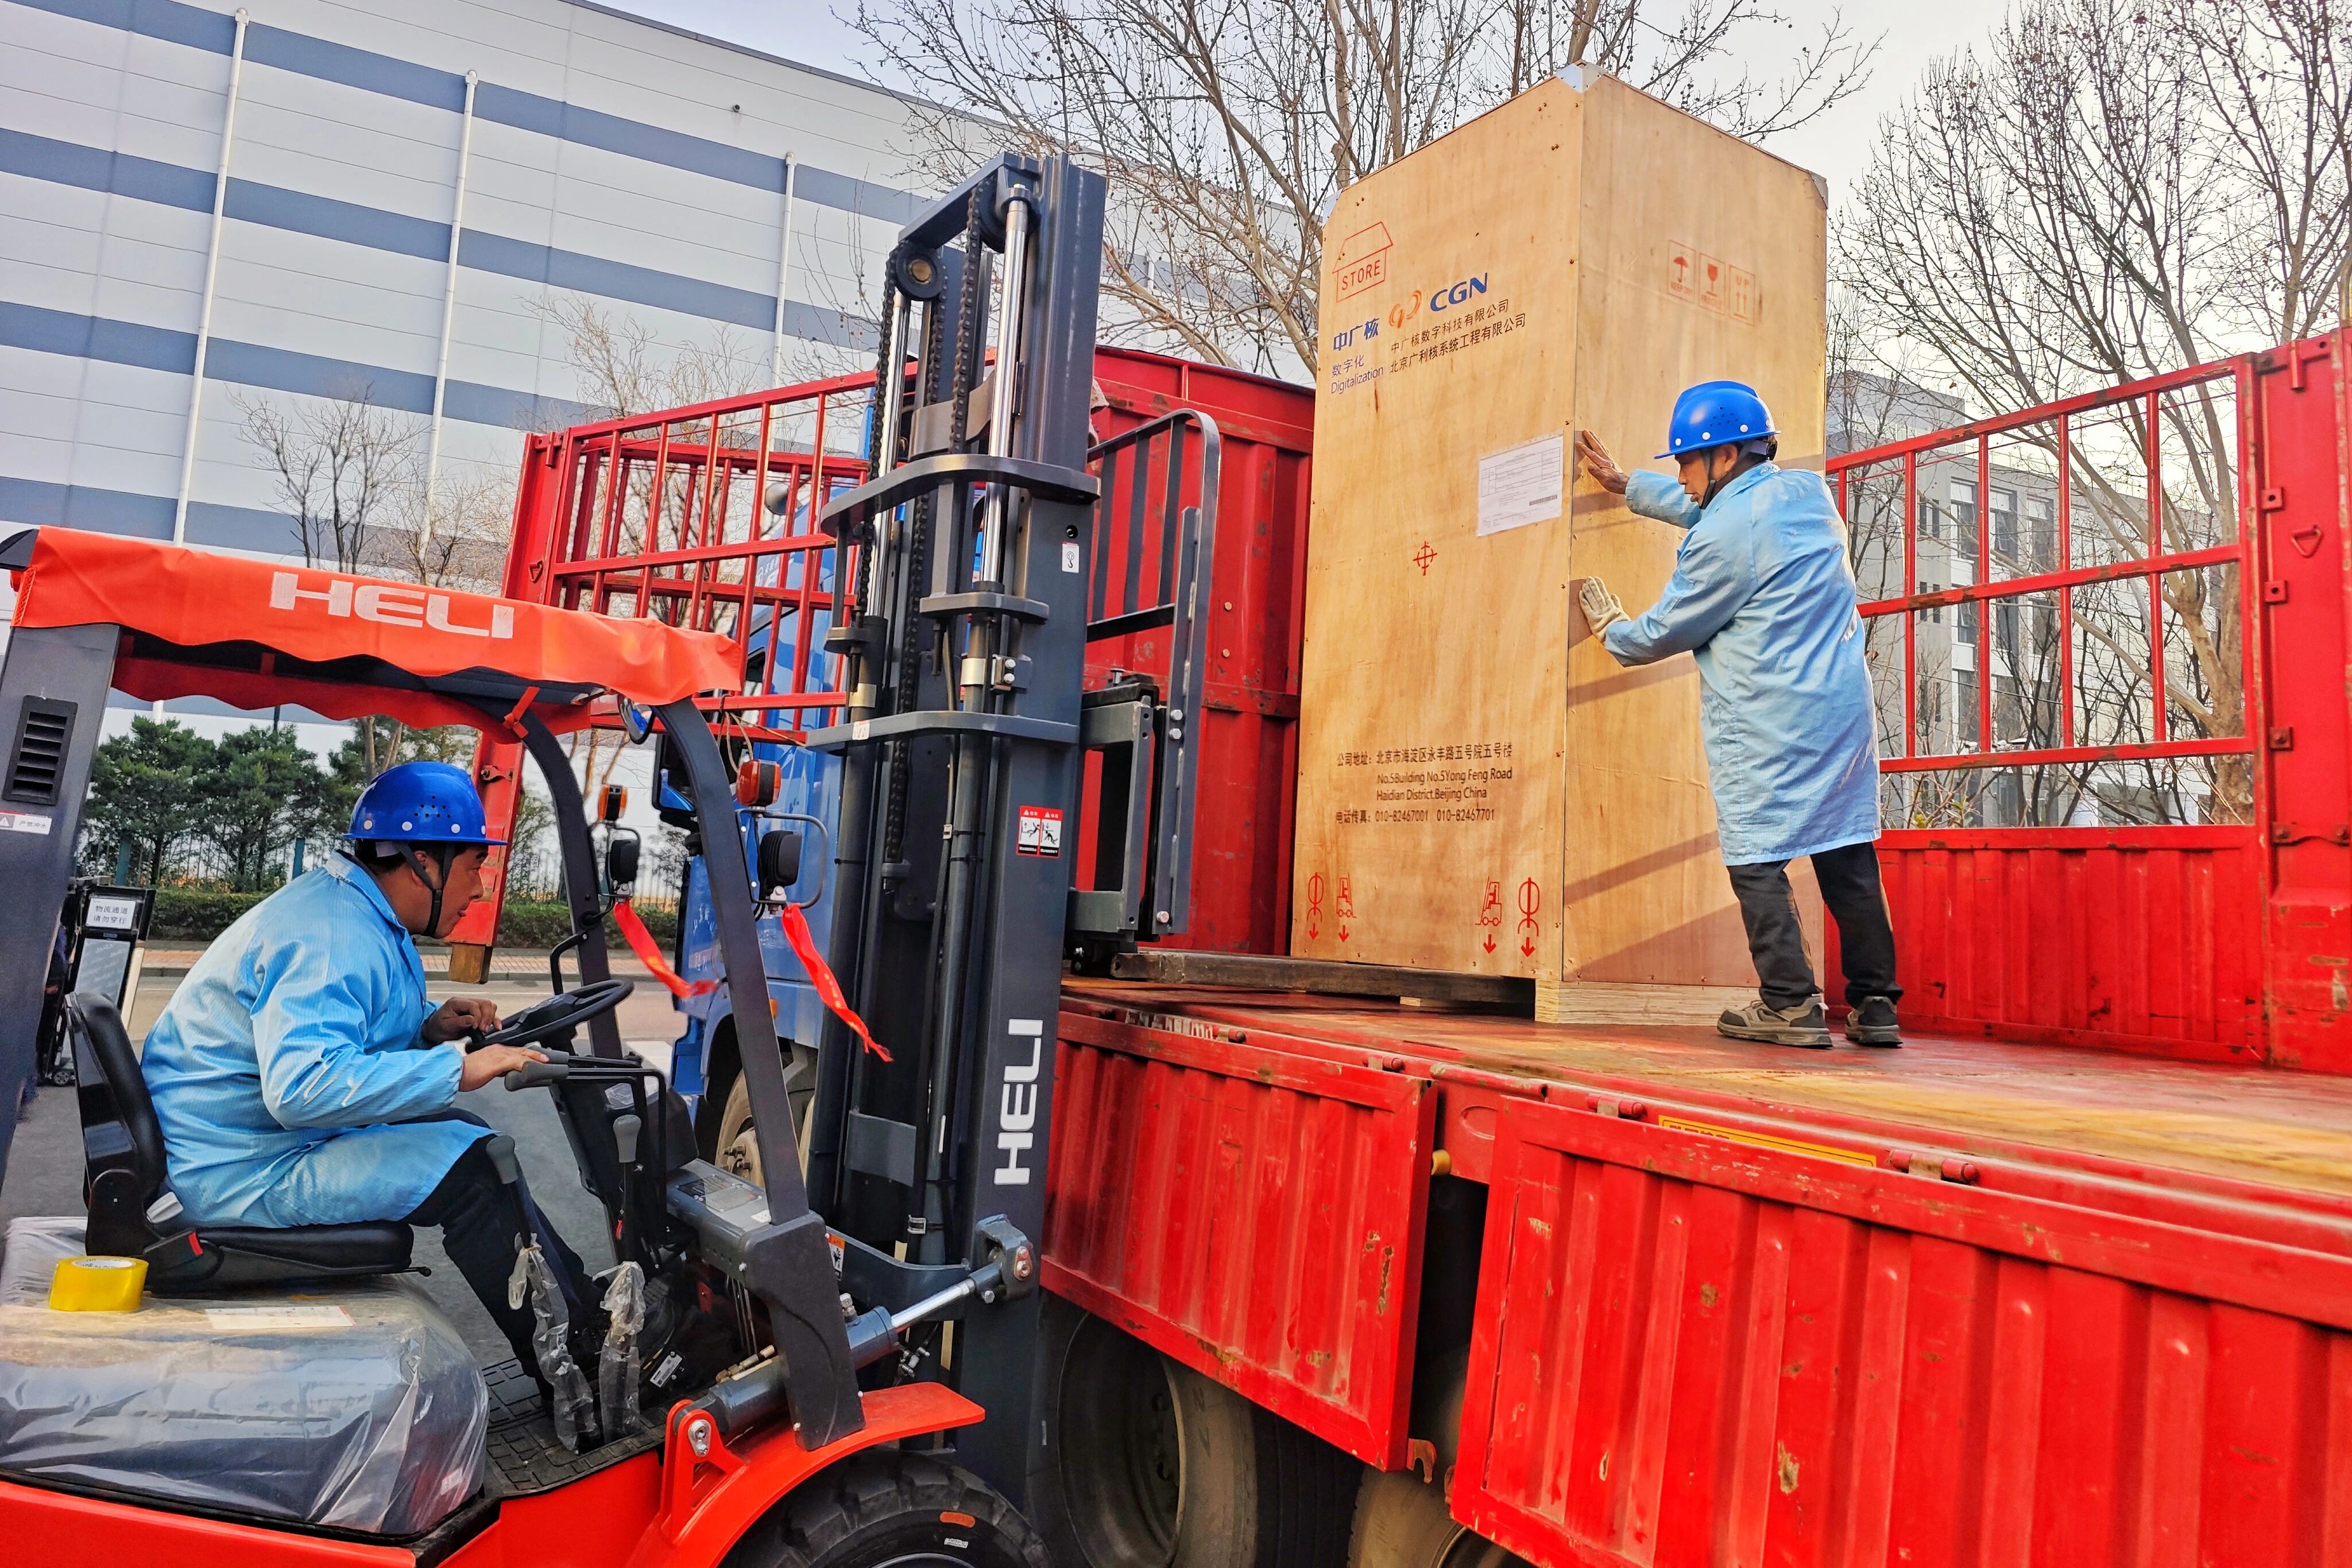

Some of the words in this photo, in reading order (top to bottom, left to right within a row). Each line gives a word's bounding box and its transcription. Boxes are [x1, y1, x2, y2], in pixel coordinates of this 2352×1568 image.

[1341, 260, 1381, 291] STORE
[1736, 276, 1750, 287] UP
[1430, 272, 1488, 312] CGN
[1333, 318, 1379, 351] 中广核
[1391, 299, 1508, 354] 中广核数字科技有限公司
[1390, 313, 1526, 373] 北京广利核系统工程有限公司
[1332, 355, 1364, 378] 数字化
[1331, 367, 1383, 394] Digitalization
[269, 571, 515, 639] HELI
[1468, 769, 1488, 783] Feng
[1490, 766, 1512, 780] Road
[1376, 789, 1405, 800] Haidian
[1463, 787, 1487, 799] China
[1437, 808, 1495, 822] 010-82467701
[94, 915, 126, 924] 请勿穿行
[95, 905, 128, 915] 物流通道
[993, 1019, 1043, 1185] HELI
